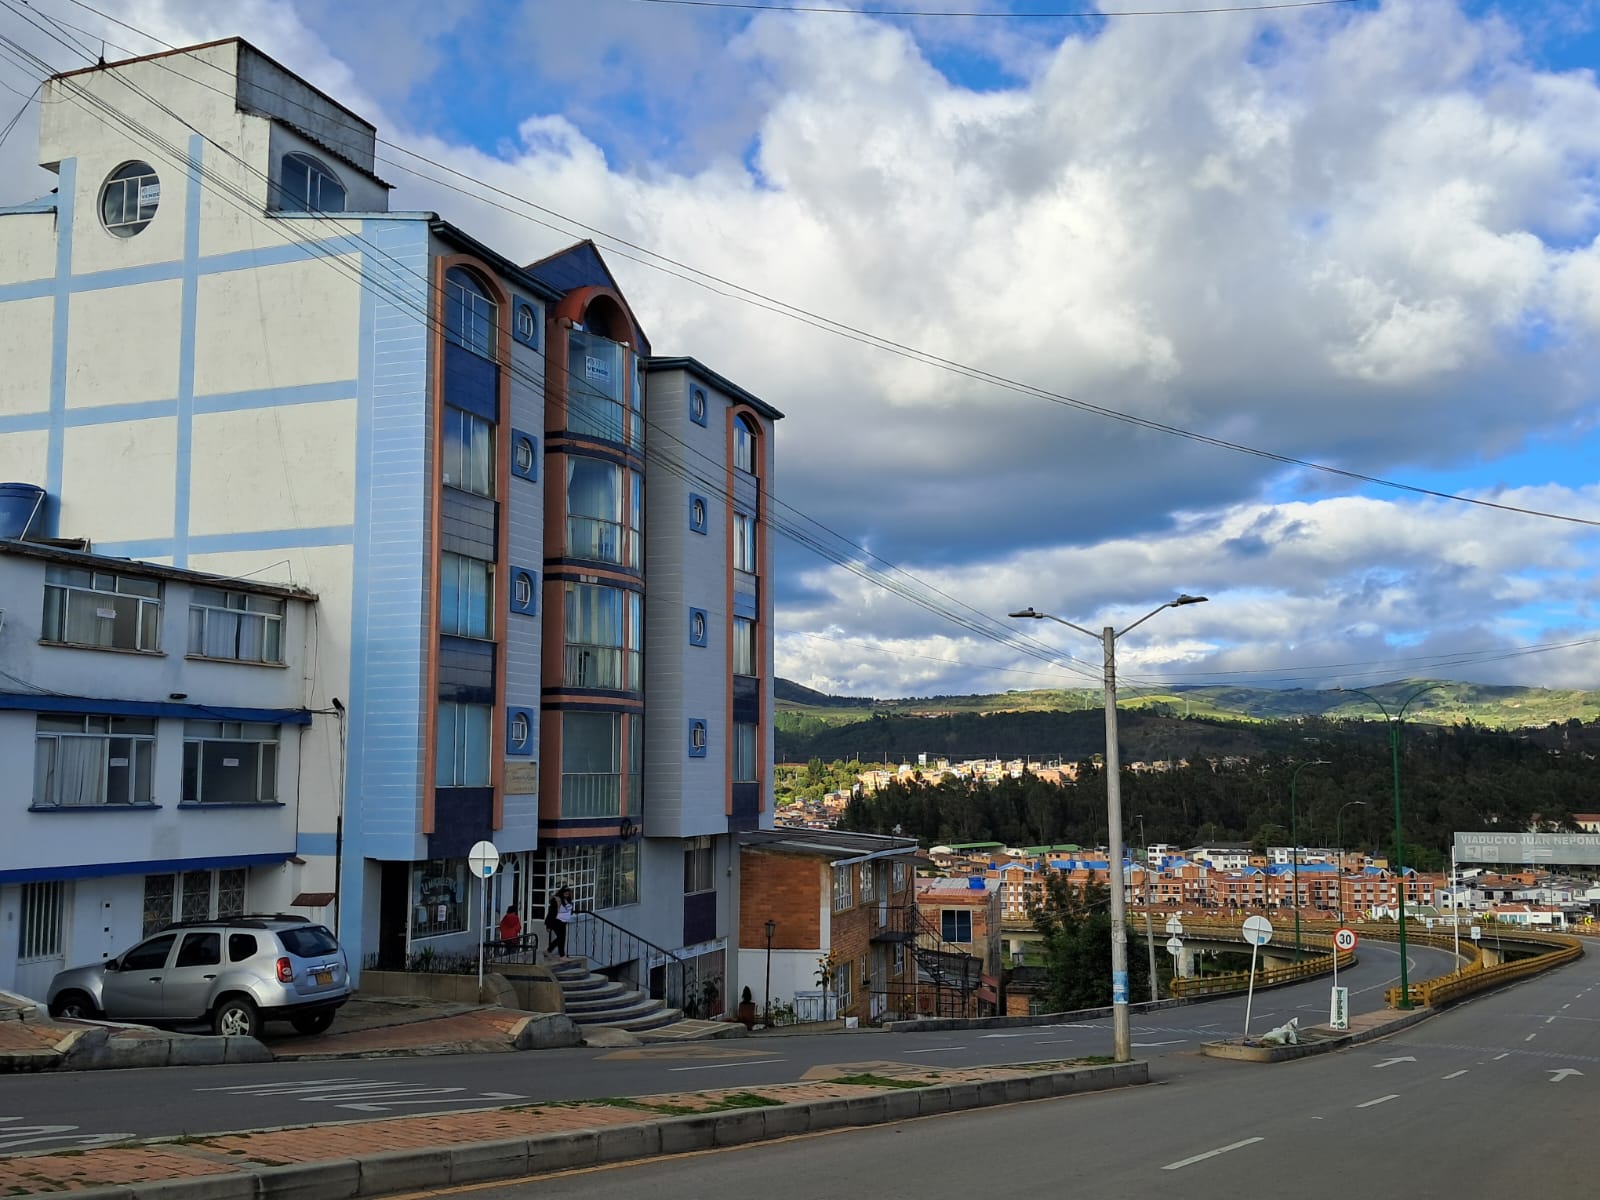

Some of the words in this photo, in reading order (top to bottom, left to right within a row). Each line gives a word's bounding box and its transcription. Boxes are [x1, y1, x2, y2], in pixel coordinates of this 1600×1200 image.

[1461, 835, 1516, 845] VIADUCTO
[1520, 836, 1550, 845] JUAN
[1339, 934, 1352, 945] 30
